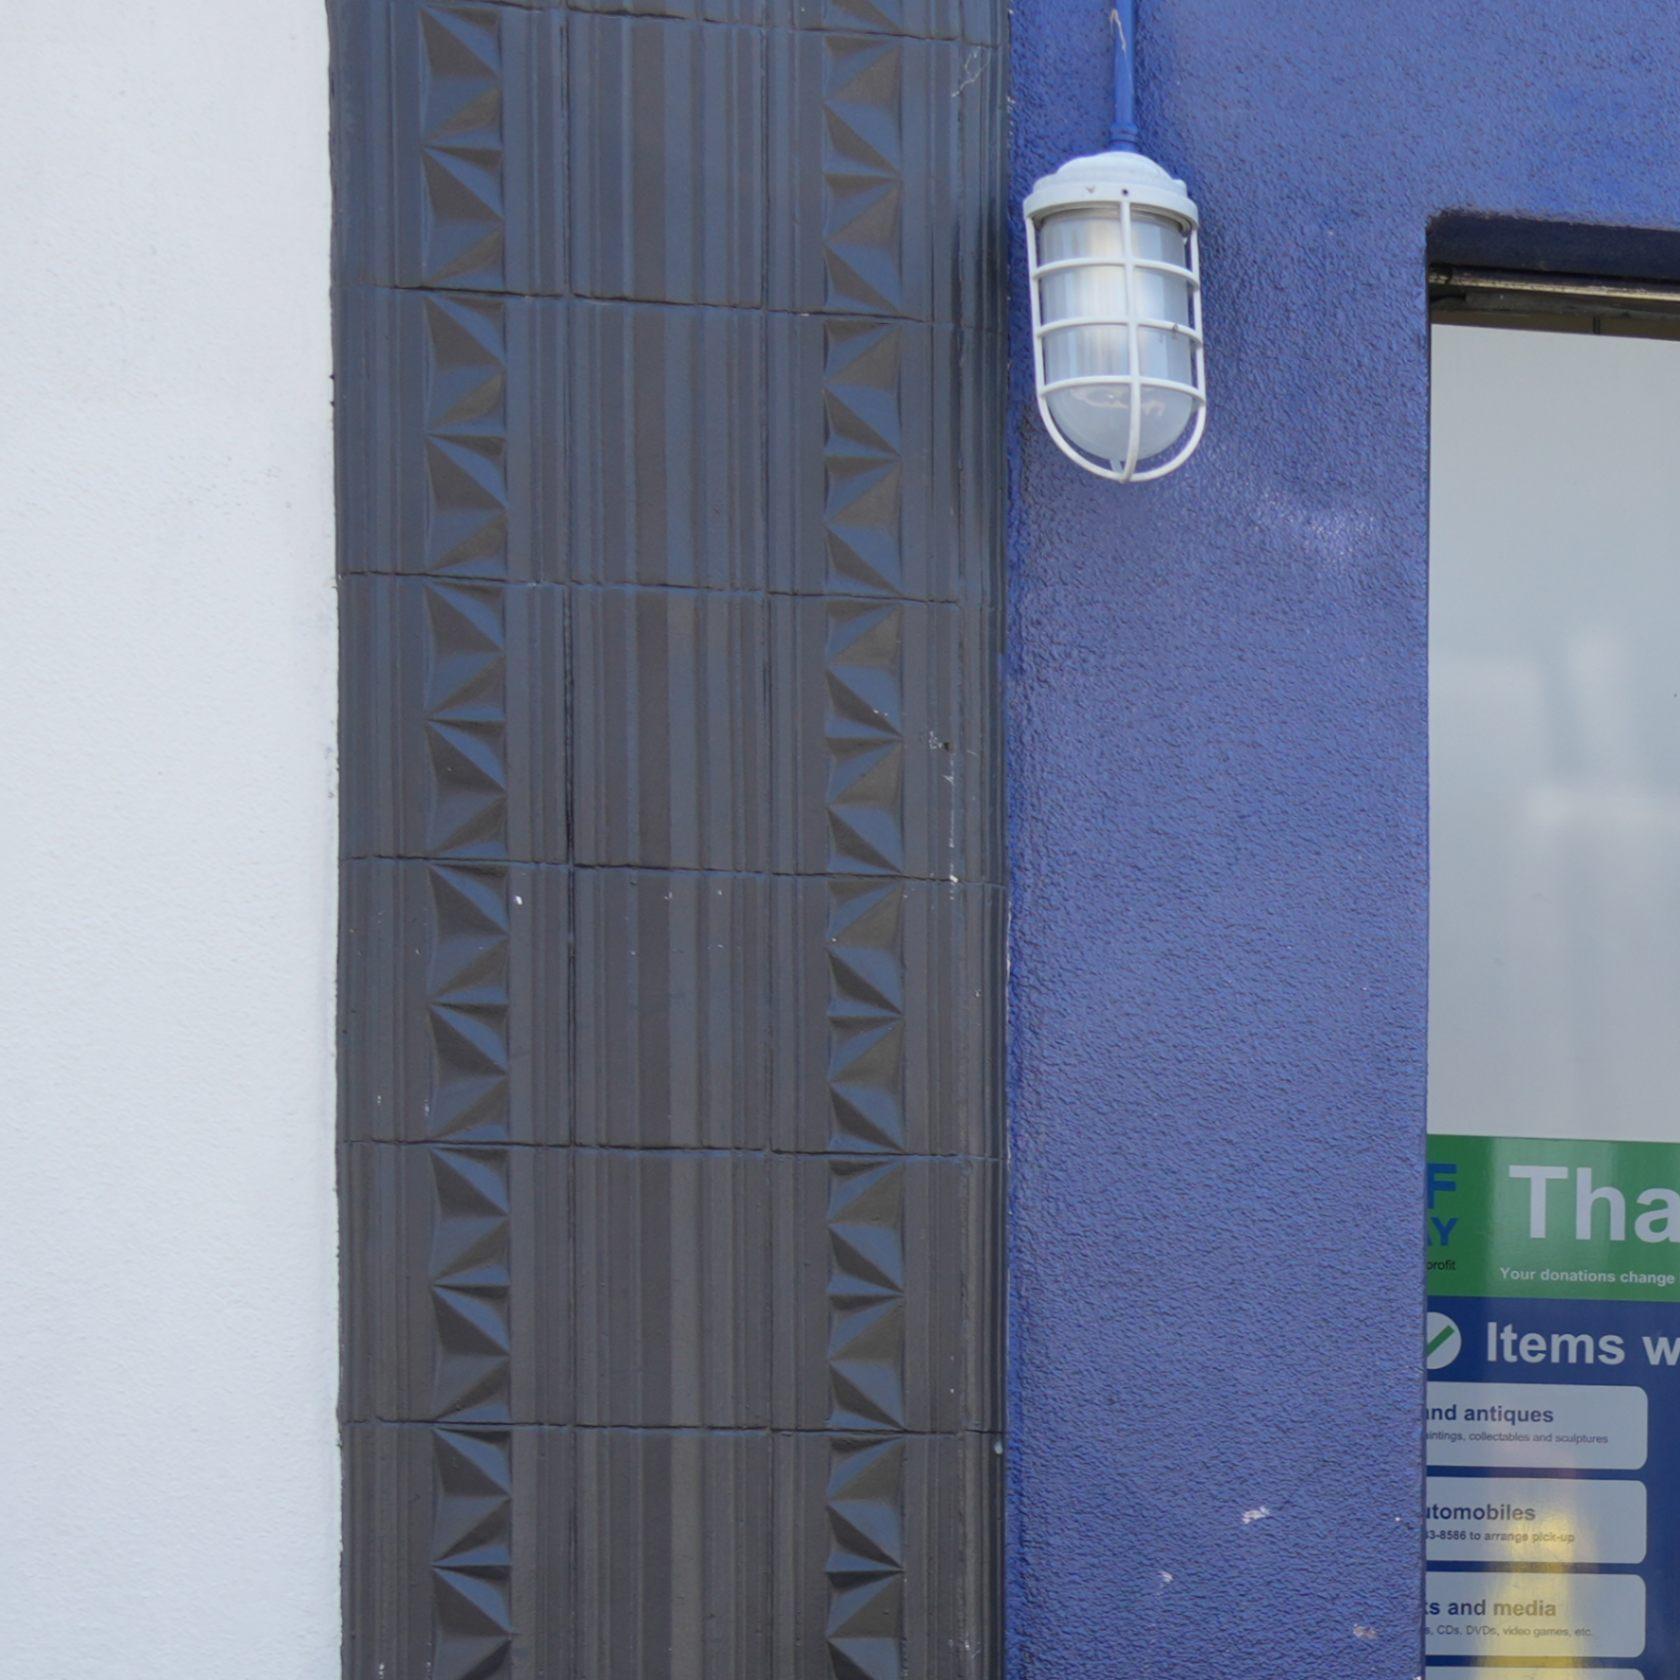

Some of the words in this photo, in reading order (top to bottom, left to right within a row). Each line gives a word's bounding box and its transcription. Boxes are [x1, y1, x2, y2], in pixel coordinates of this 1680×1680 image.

[1500, 1267, 1535, 1280] Your
[1540, 1268, 1616, 1283] donations
[1620, 1271, 1675, 1287] change
[1486, 1321, 1626, 1366] Items
[1464, 1405, 1554, 1426] antiques
[1468, 1432, 1530, 1443] collectables
[1532, 1433, 1552, 1443] and
[1555, 1433, 1609, 1446] sculptures
[1448, 1599, 1486, 1616] and
[1493, 1600, 1557, 1617] media
[1502, 1626, 1531, 1637] video
